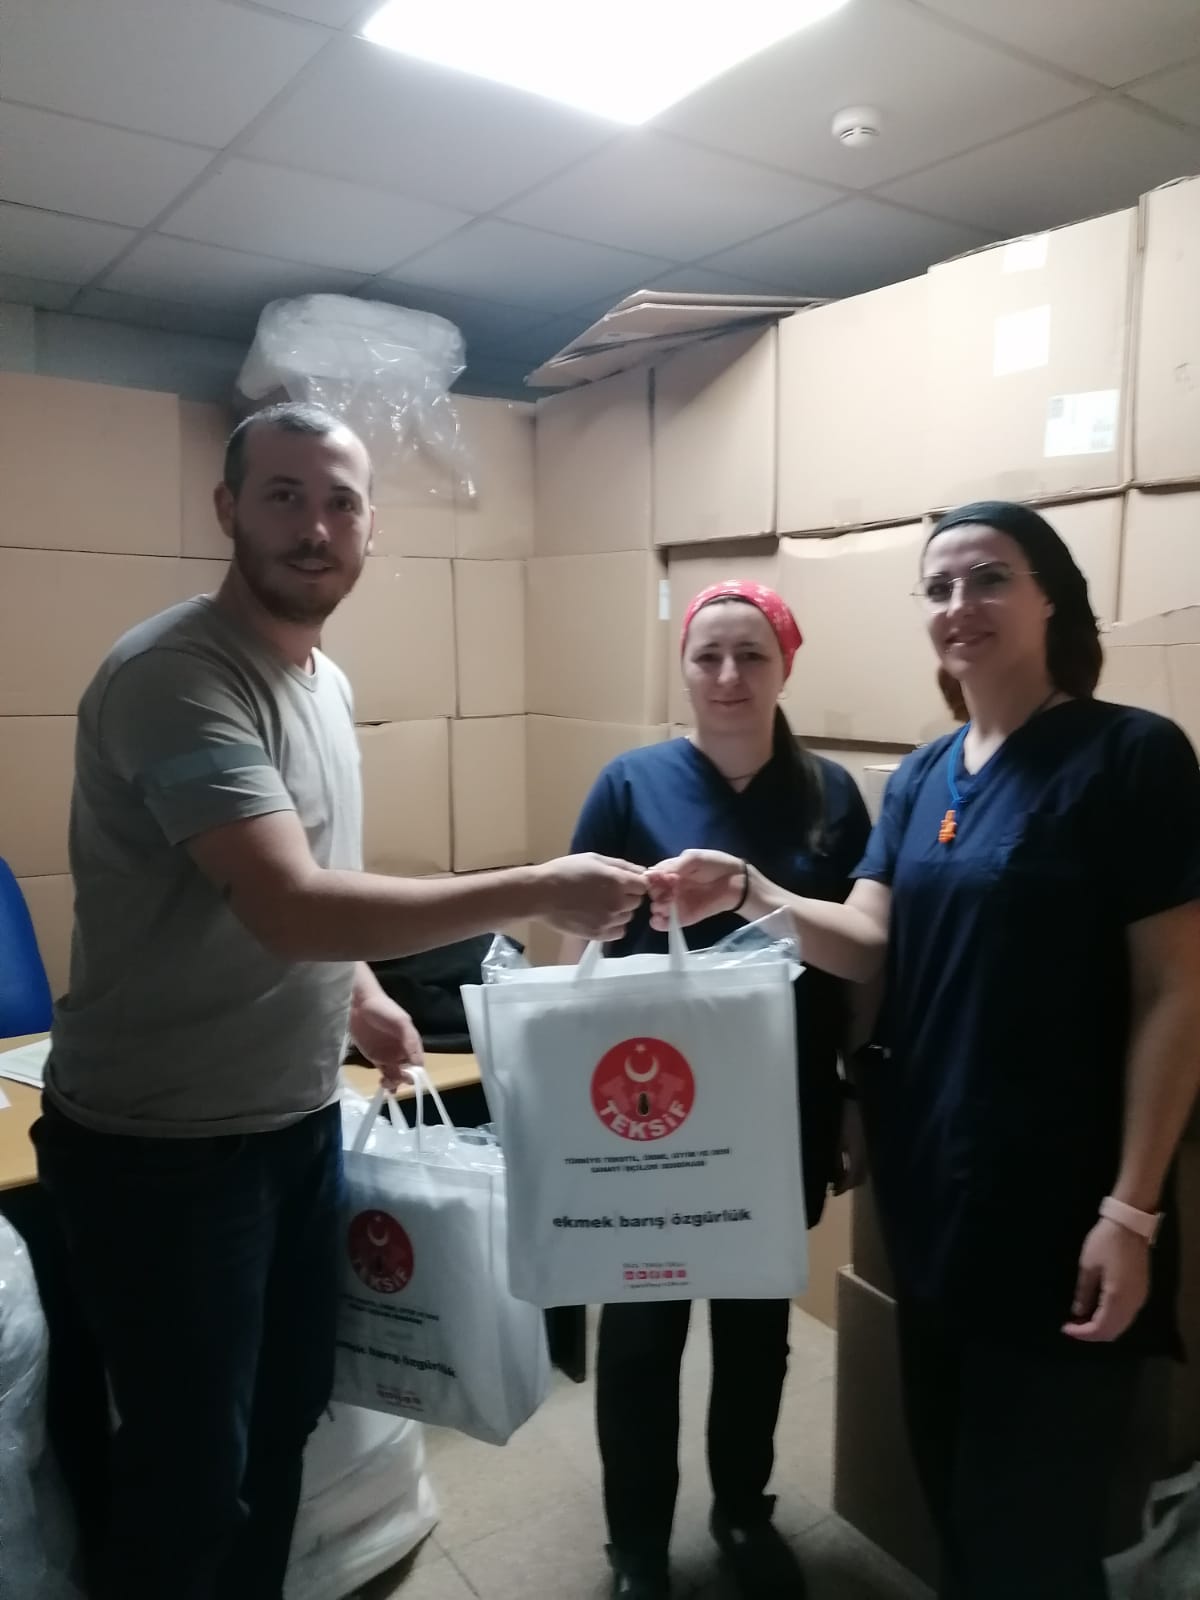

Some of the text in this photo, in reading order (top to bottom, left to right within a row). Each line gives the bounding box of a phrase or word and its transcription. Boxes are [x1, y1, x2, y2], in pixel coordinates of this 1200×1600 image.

[600, 1100, 685, 1139] TEKSİF
[552, 1208, 751, 1229] ekmek barış özgürlük
